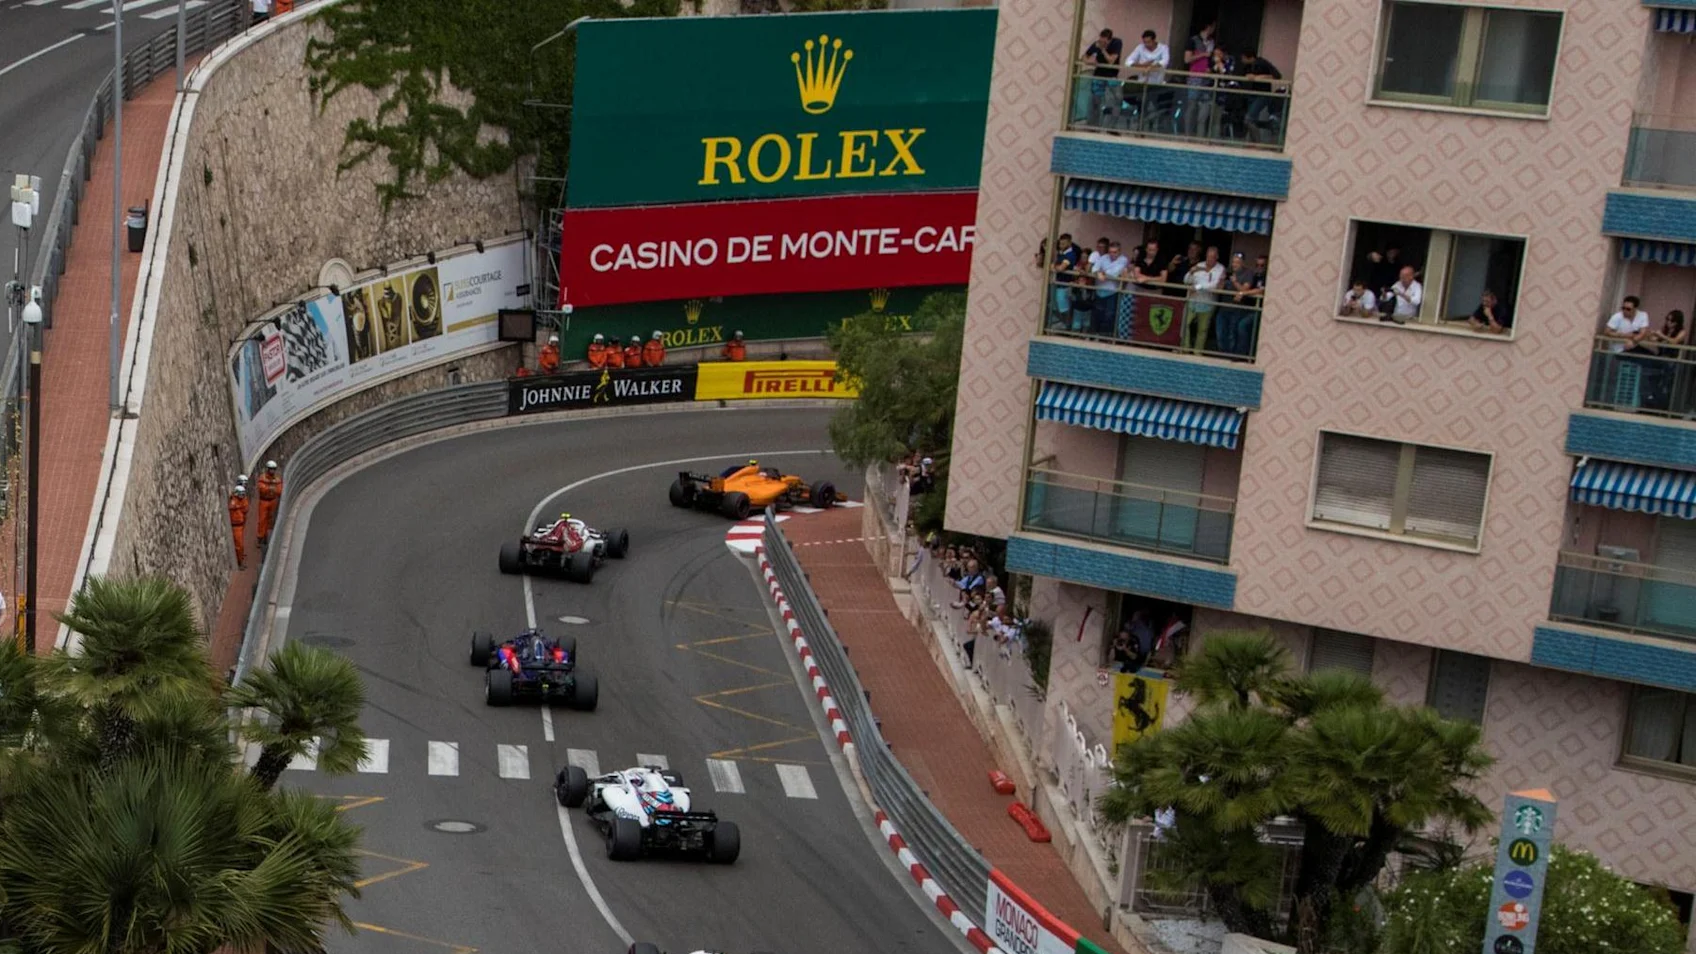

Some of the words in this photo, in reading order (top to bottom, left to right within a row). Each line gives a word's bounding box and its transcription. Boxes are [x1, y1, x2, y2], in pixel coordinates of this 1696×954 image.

[698, 128, 926, 186] ROLEX
[590, 238, 718, 272] CASINO
[726, 235, 774, 264] DE
[780, 225, 977, 260] MONTE-CAR
[660, 325, 723, 347] ROLEX
[520, 384, 592, 411] JOHNNIE
[613, 379, 682, 398] WALKER
[744, 370, 835, 393] PIRELLI
[996, 893, 1038, 949] MONACO
